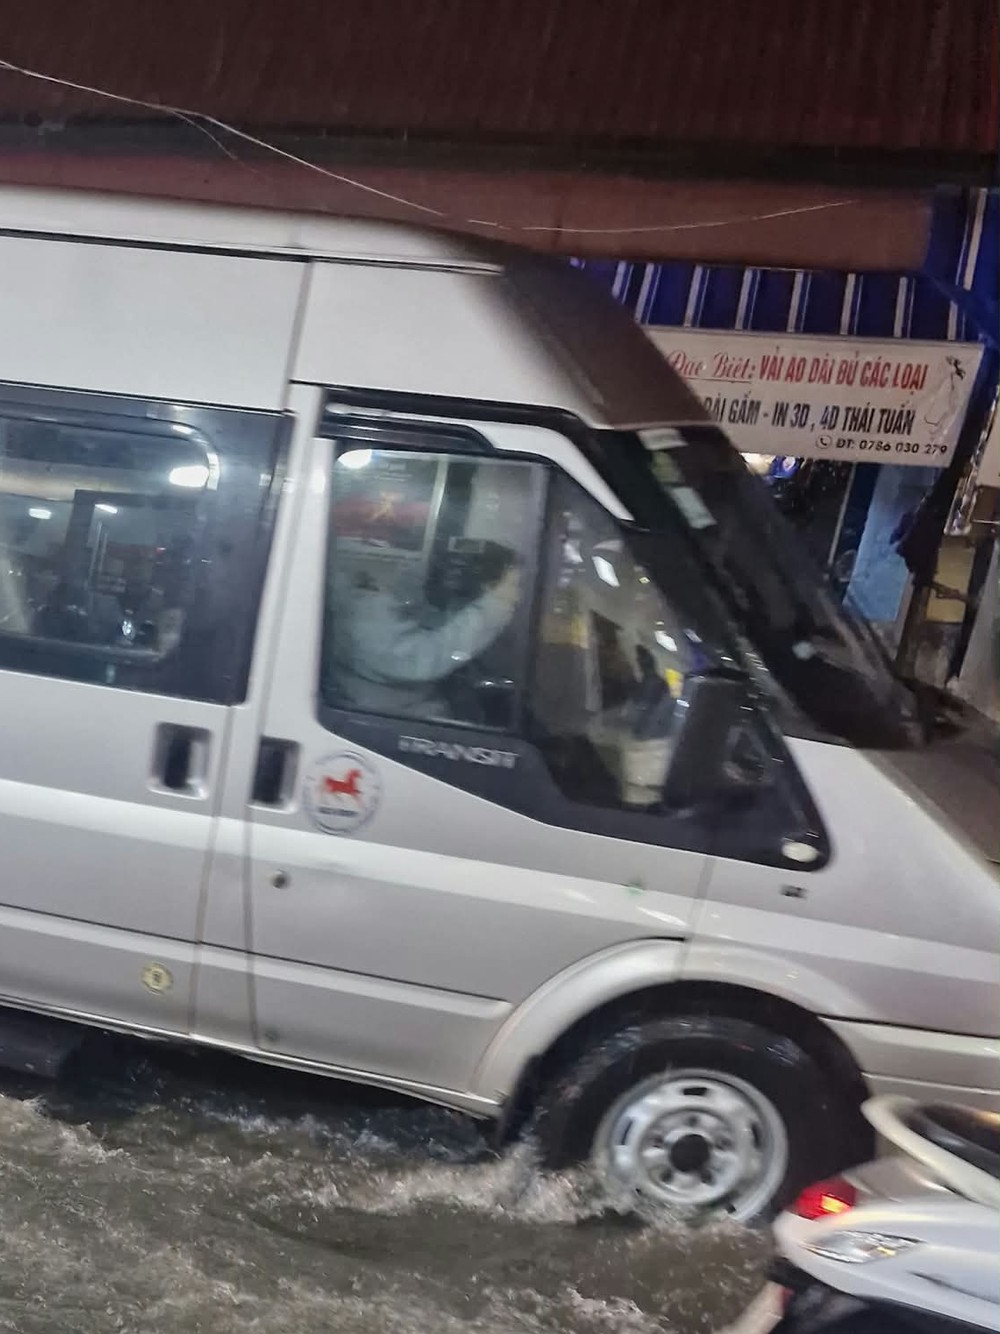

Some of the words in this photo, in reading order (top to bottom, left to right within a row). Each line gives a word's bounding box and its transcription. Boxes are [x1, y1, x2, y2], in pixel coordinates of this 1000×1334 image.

[859, 356, 891, 388] CÁC
[891, 363, 928, 395] LOẠI
[772, 402, 790, 427] IN
[820, 404, 840, 430] 4D
[842, 402, 876, 433] THÁI
[895, 443, 919, 454] 030
[398, 735, 521, 769] TRANSIT
